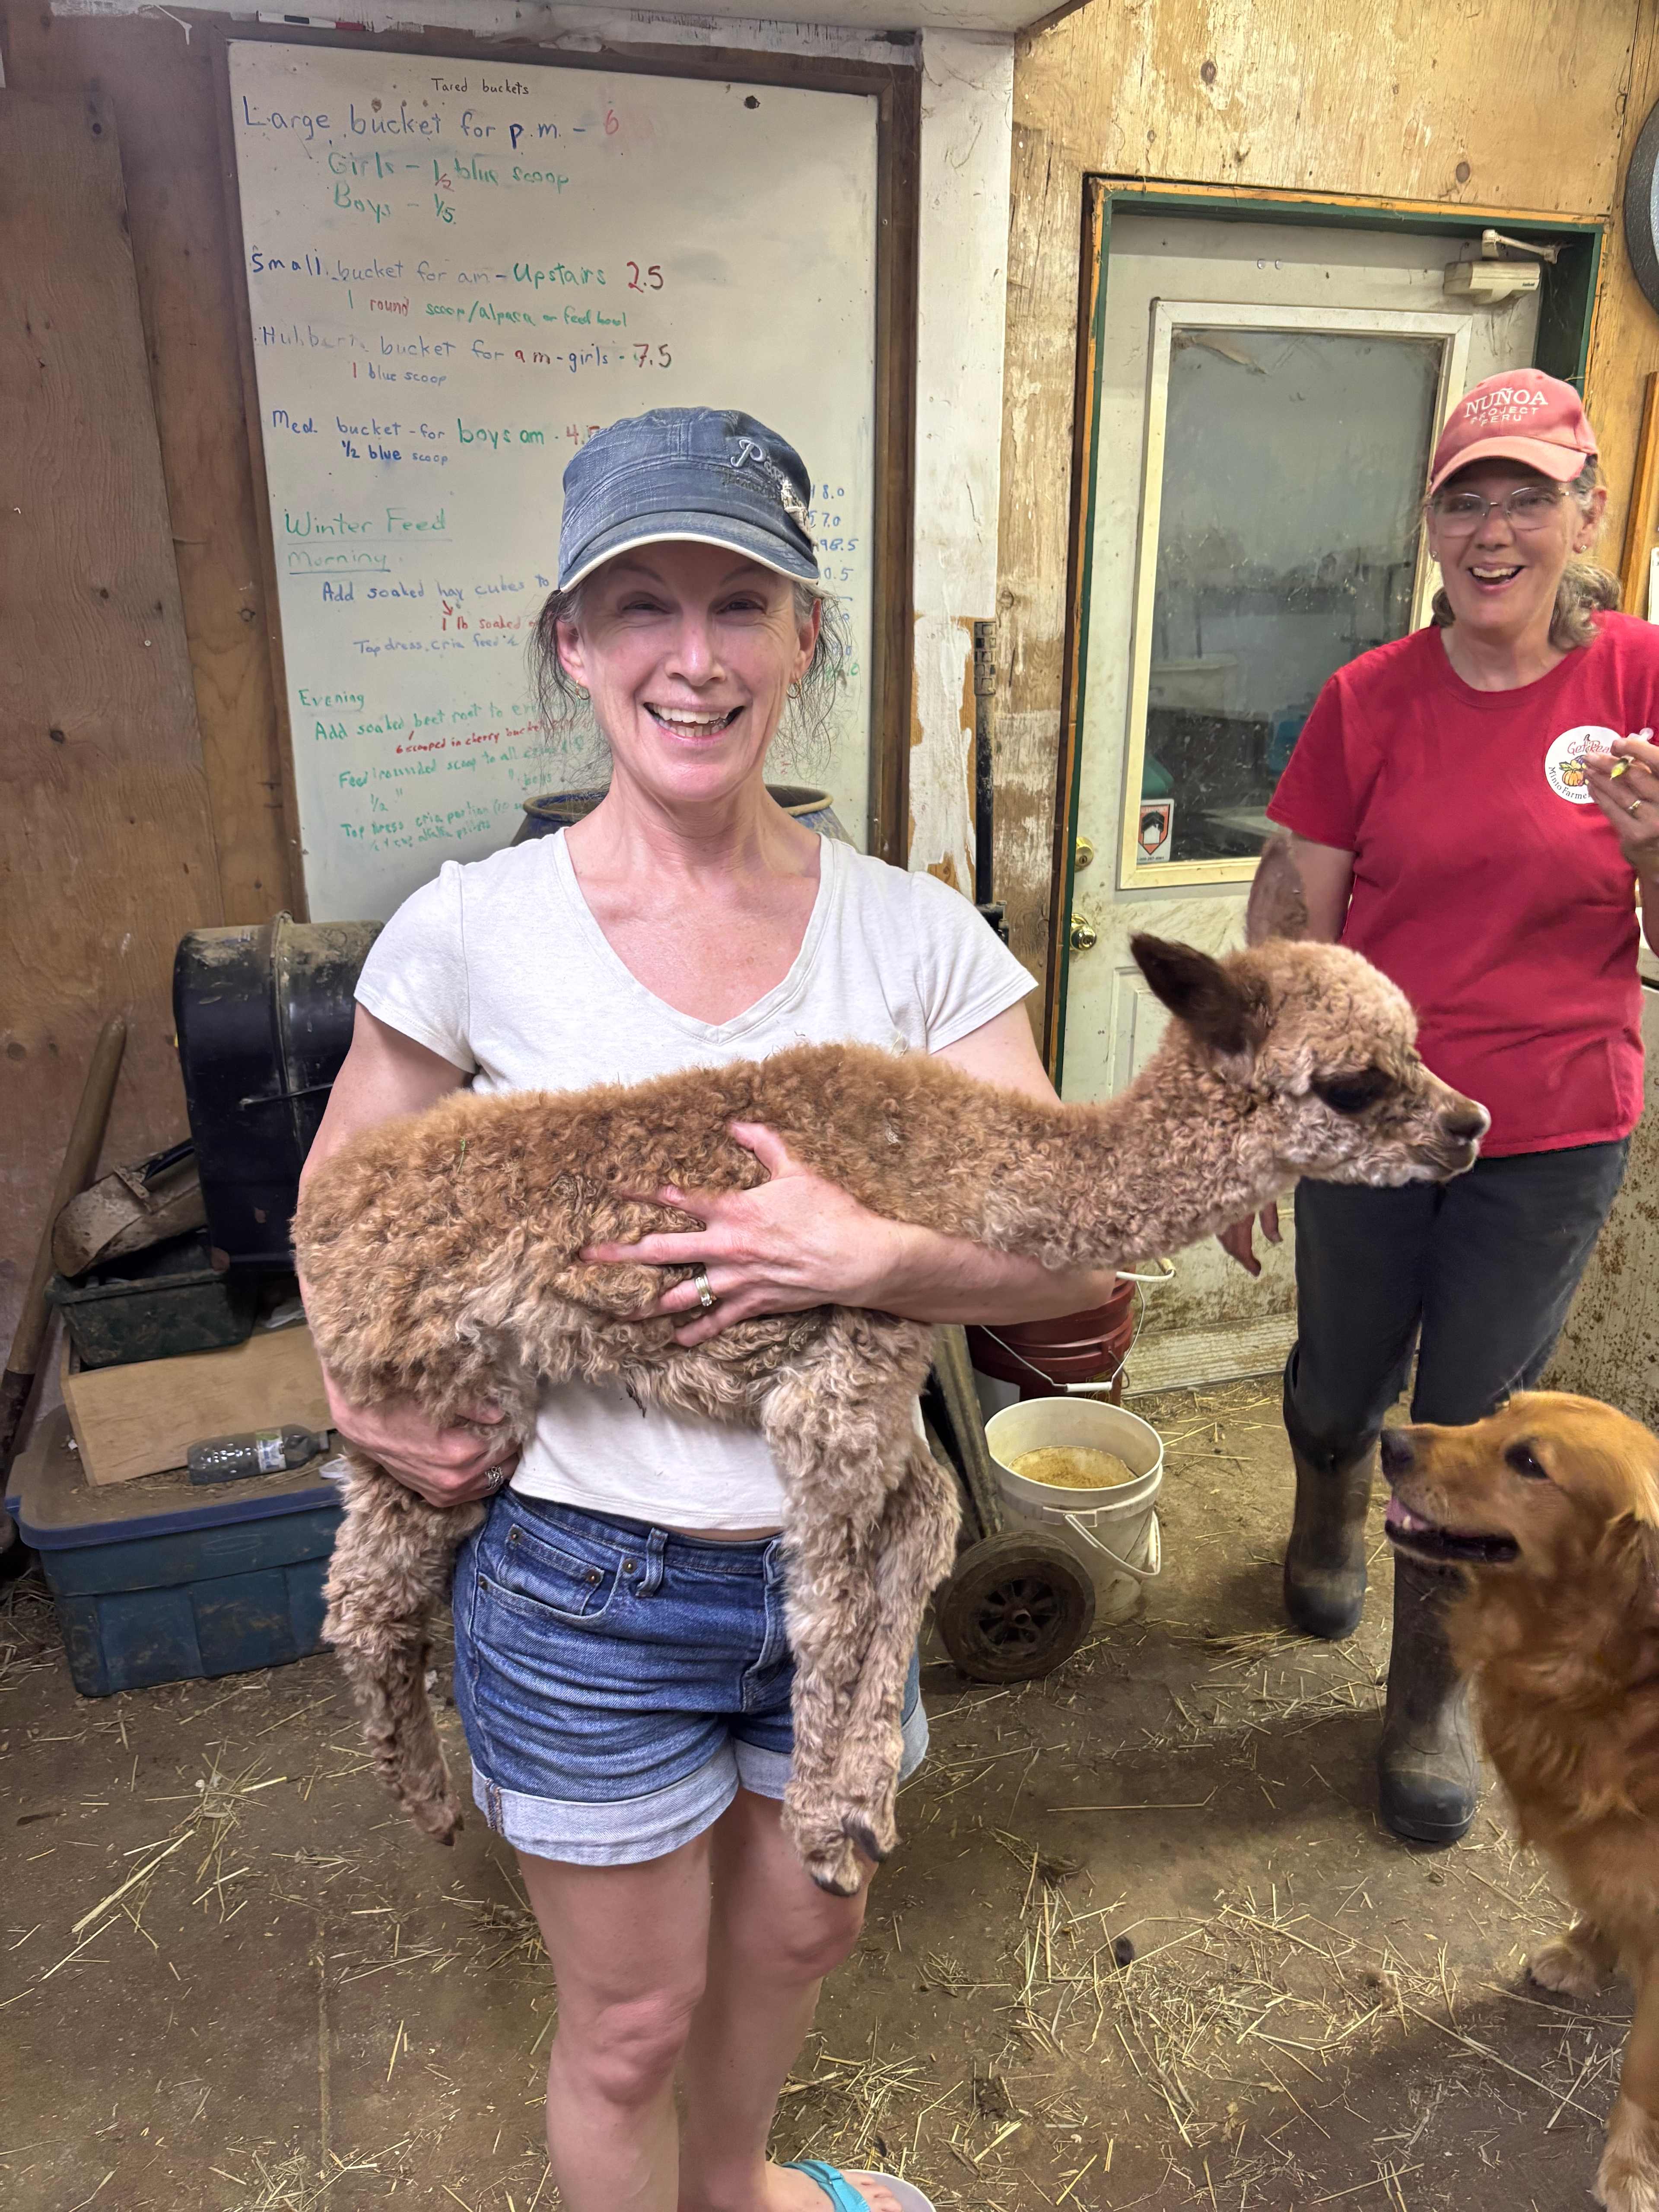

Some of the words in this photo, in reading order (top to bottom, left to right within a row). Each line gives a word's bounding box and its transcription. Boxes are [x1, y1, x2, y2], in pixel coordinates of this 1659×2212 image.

[432, 78, 467, 92] Tared
[482, 79, 529, 95] buckets
[243, 95, 330, 140] Large
[350, 103, 441, 136] bucket
[461, 111, 496, 137] for
[328, 151, 394, 178] Girls
[512, 166, 569, 194] scoop
[252, 253, 321, 276] Small
[337, 259, 404, 282] bucket
[417, 261, 447, 282] for
[626, 261, 664, 292] 2.5
[370, 296, 409, 317] round
[564, 305, 592, 324] feed
[597, 311, 627, 327] bowl
[381, 335, 457, 357] bucket
[472, 339, 505, 360] for
[633, 343, 672, 368] 7.5
[369, 362, 397, 381] blue
[404, 371, 447, 387] scoop
[1463, 387, 1548, 418] NUÑOA
[337, 416, 401, 437] bucket
[457, 418, 511, 450] boys
[520, 428, 545, 445] am
[341, 440, 360, 458] 1/2
[369, 445, 402, 461] blue
[412, 451, 449, 466] scoop
[285, 510, 373, 537] Winter
[386, 507, 446, 533] Feed
[288, 550, 388, 571] Morning
[322, 581, 354, 601] Add
[367, 580, 425, 599] soaked
[435, 579, 464, 601] hay
[475, 575, 524, 595] cubes
[458, 616, 468, 629] lb
[480, 615, 521, 629] soaked
[431, 639, 464, 650] cria
[298, 689, 364, 711] Evening
[315, 721, 348, 741] Add
[357, 714, 405, 735] soaked
[490, 702, 503, 718] to
[451, 737, 462, 747] in
[465, 732, 500, 746] cherry
[1589, 740, 1611, 753] Rea
[339, 771, 368, 788] Feed
[482, 750, 496, 764] to
[1548, 766, 1562, 790] Minto
